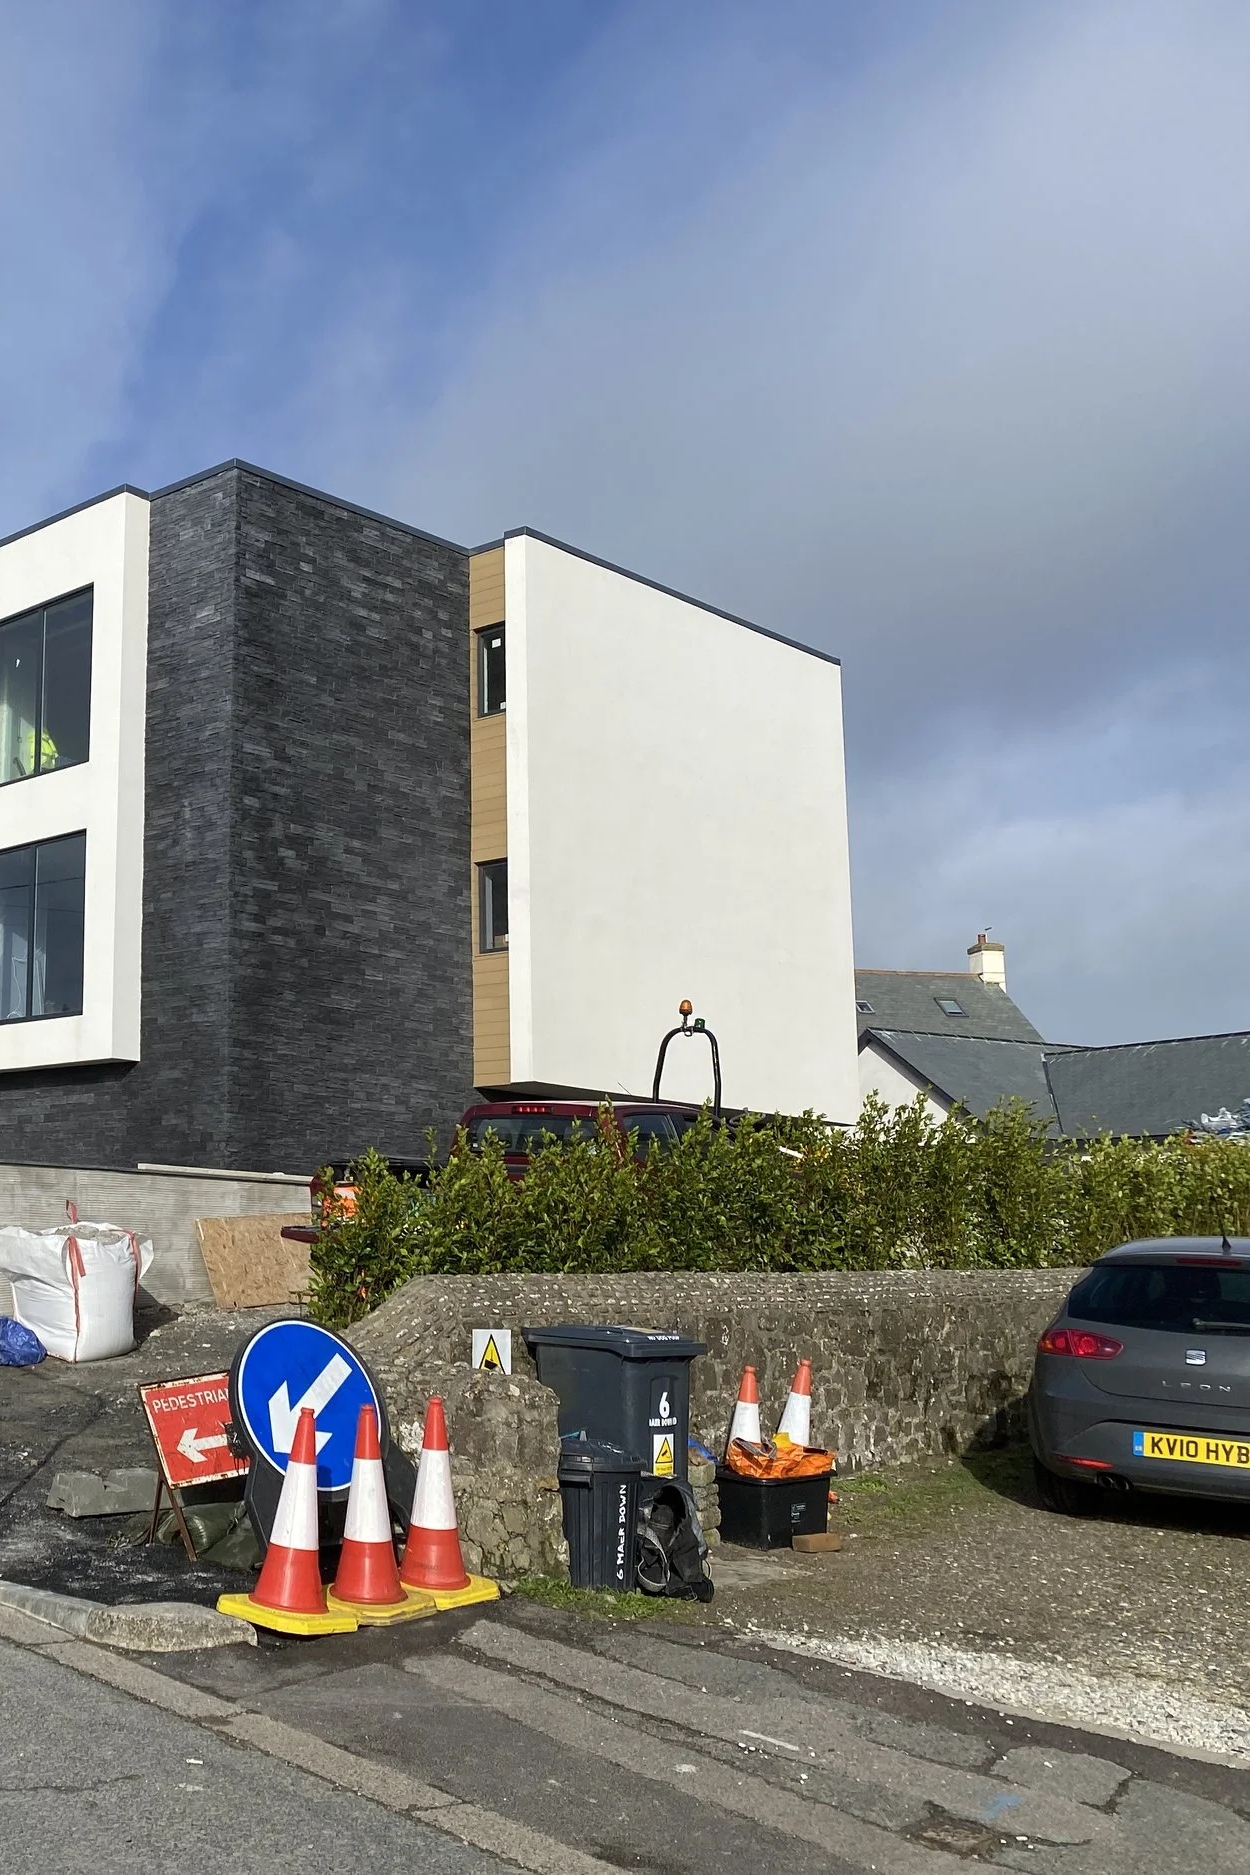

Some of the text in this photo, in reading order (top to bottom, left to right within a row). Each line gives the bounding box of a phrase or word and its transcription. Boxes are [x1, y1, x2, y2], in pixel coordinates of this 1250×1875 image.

[659, 1391, 671, 1418] 6
[1151, 1436, 1198, 1459] KV10
[616, 1484, 627, 1580] 6 MAER DOWN
